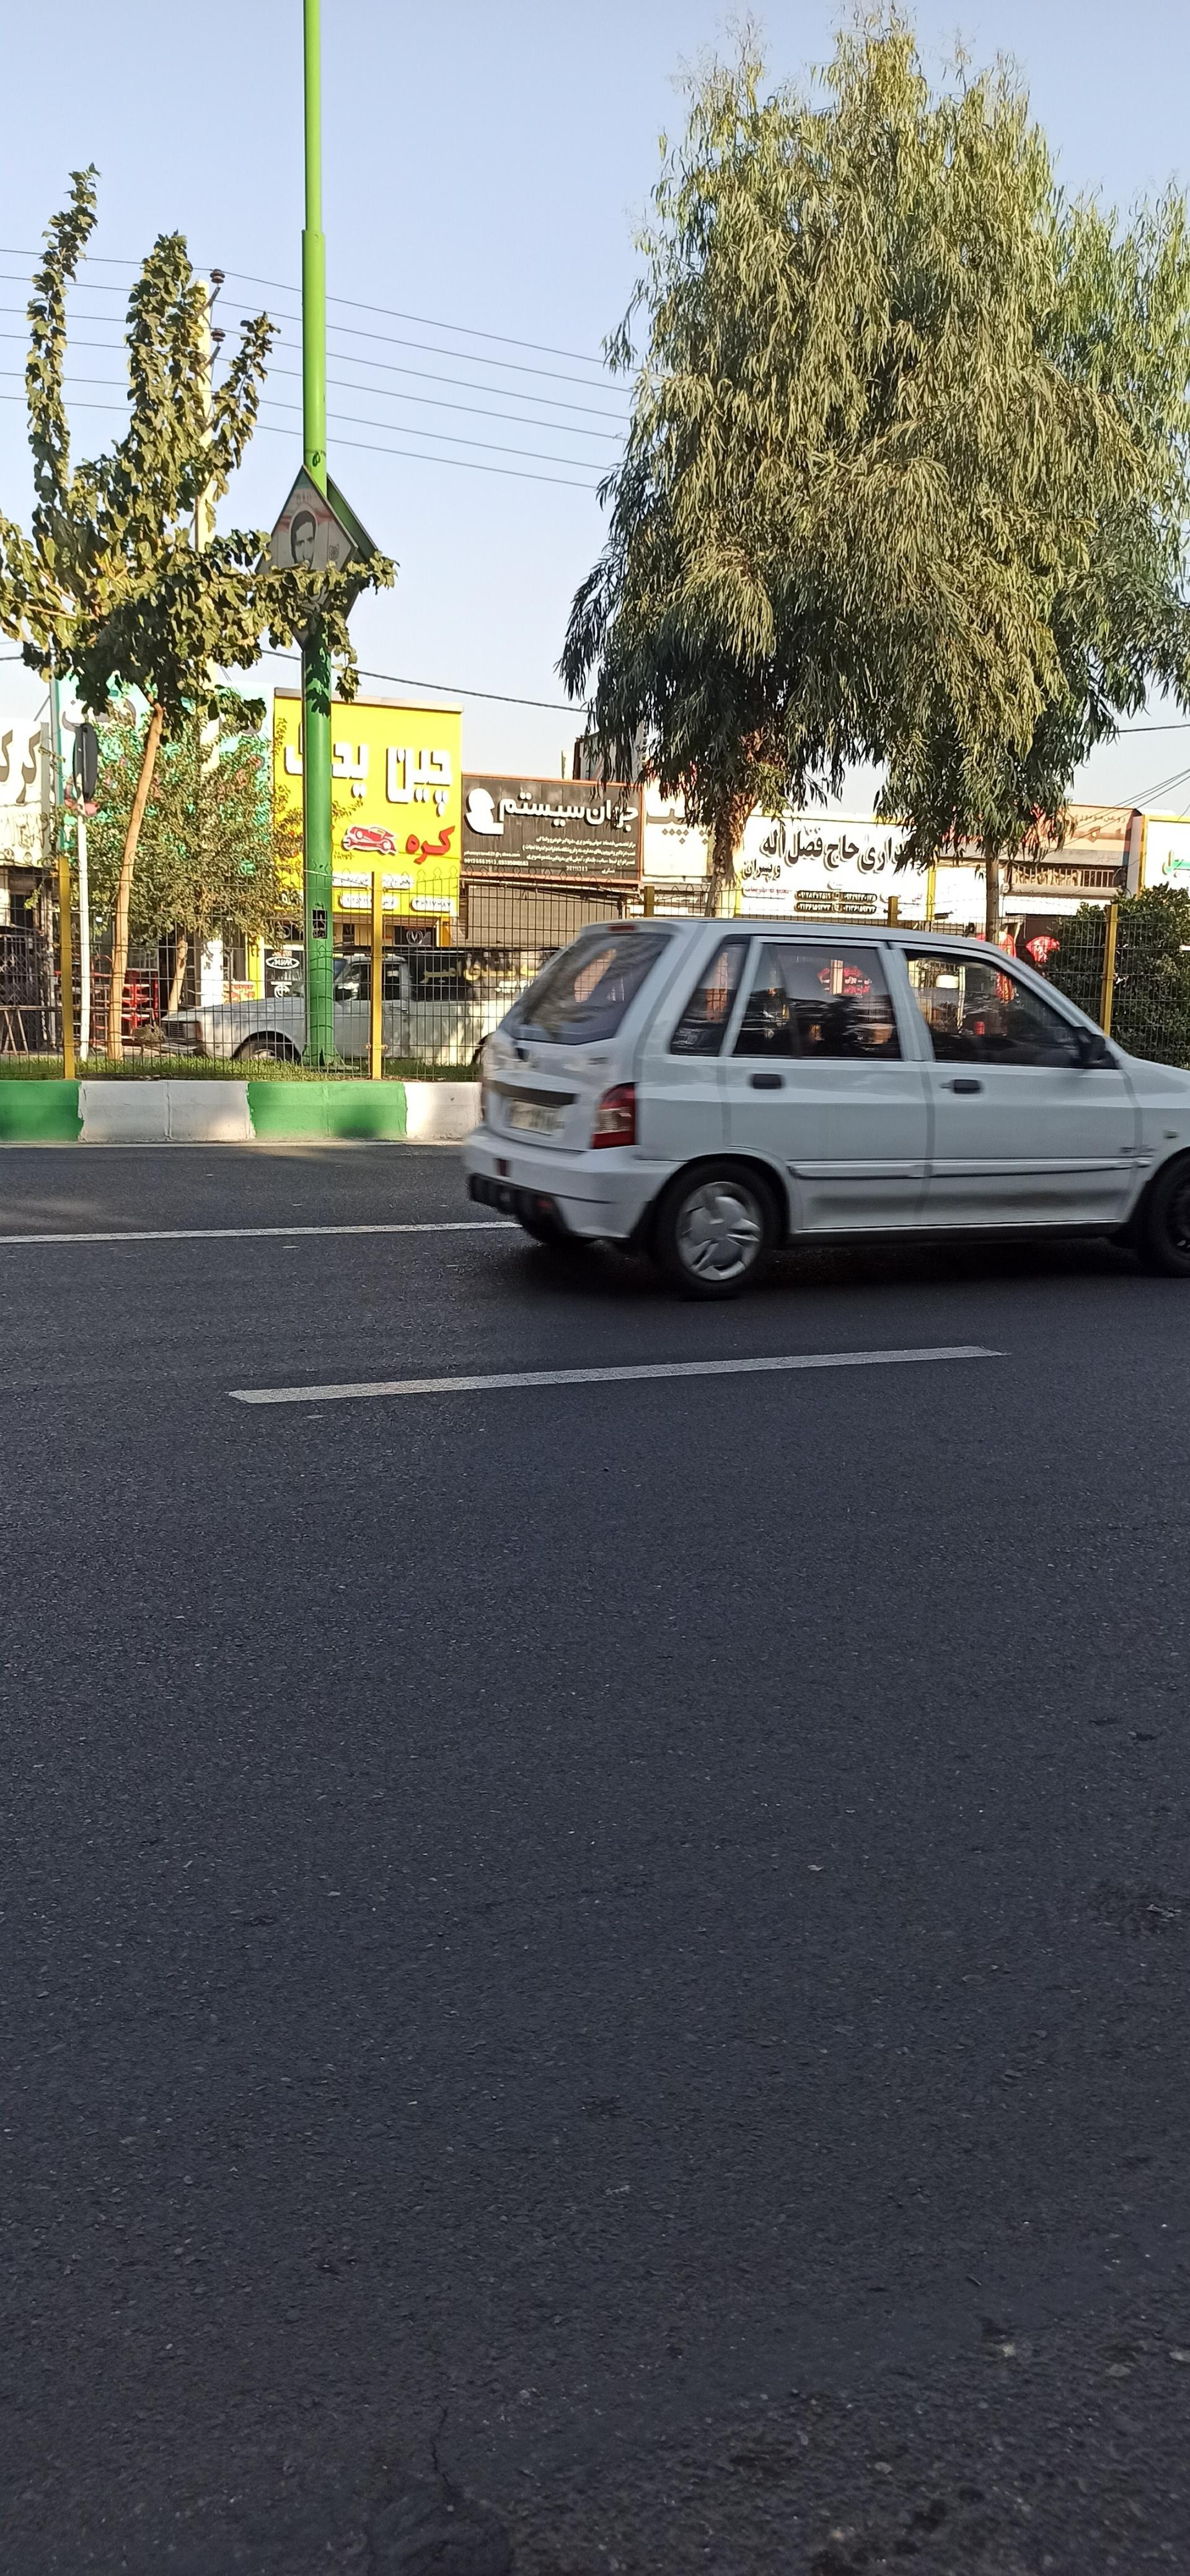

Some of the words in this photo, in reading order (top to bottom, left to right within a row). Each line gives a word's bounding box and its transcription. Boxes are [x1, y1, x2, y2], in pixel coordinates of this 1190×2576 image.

[386, 747, 452, 818] چین
[499, 792, 585, 827] سیستم
[405, 826, 455, 864] کره
[787, 826, 823, 865] فضل
[824, 834, 860, 870] حاج
[743, 860, 772, 883] پسران
